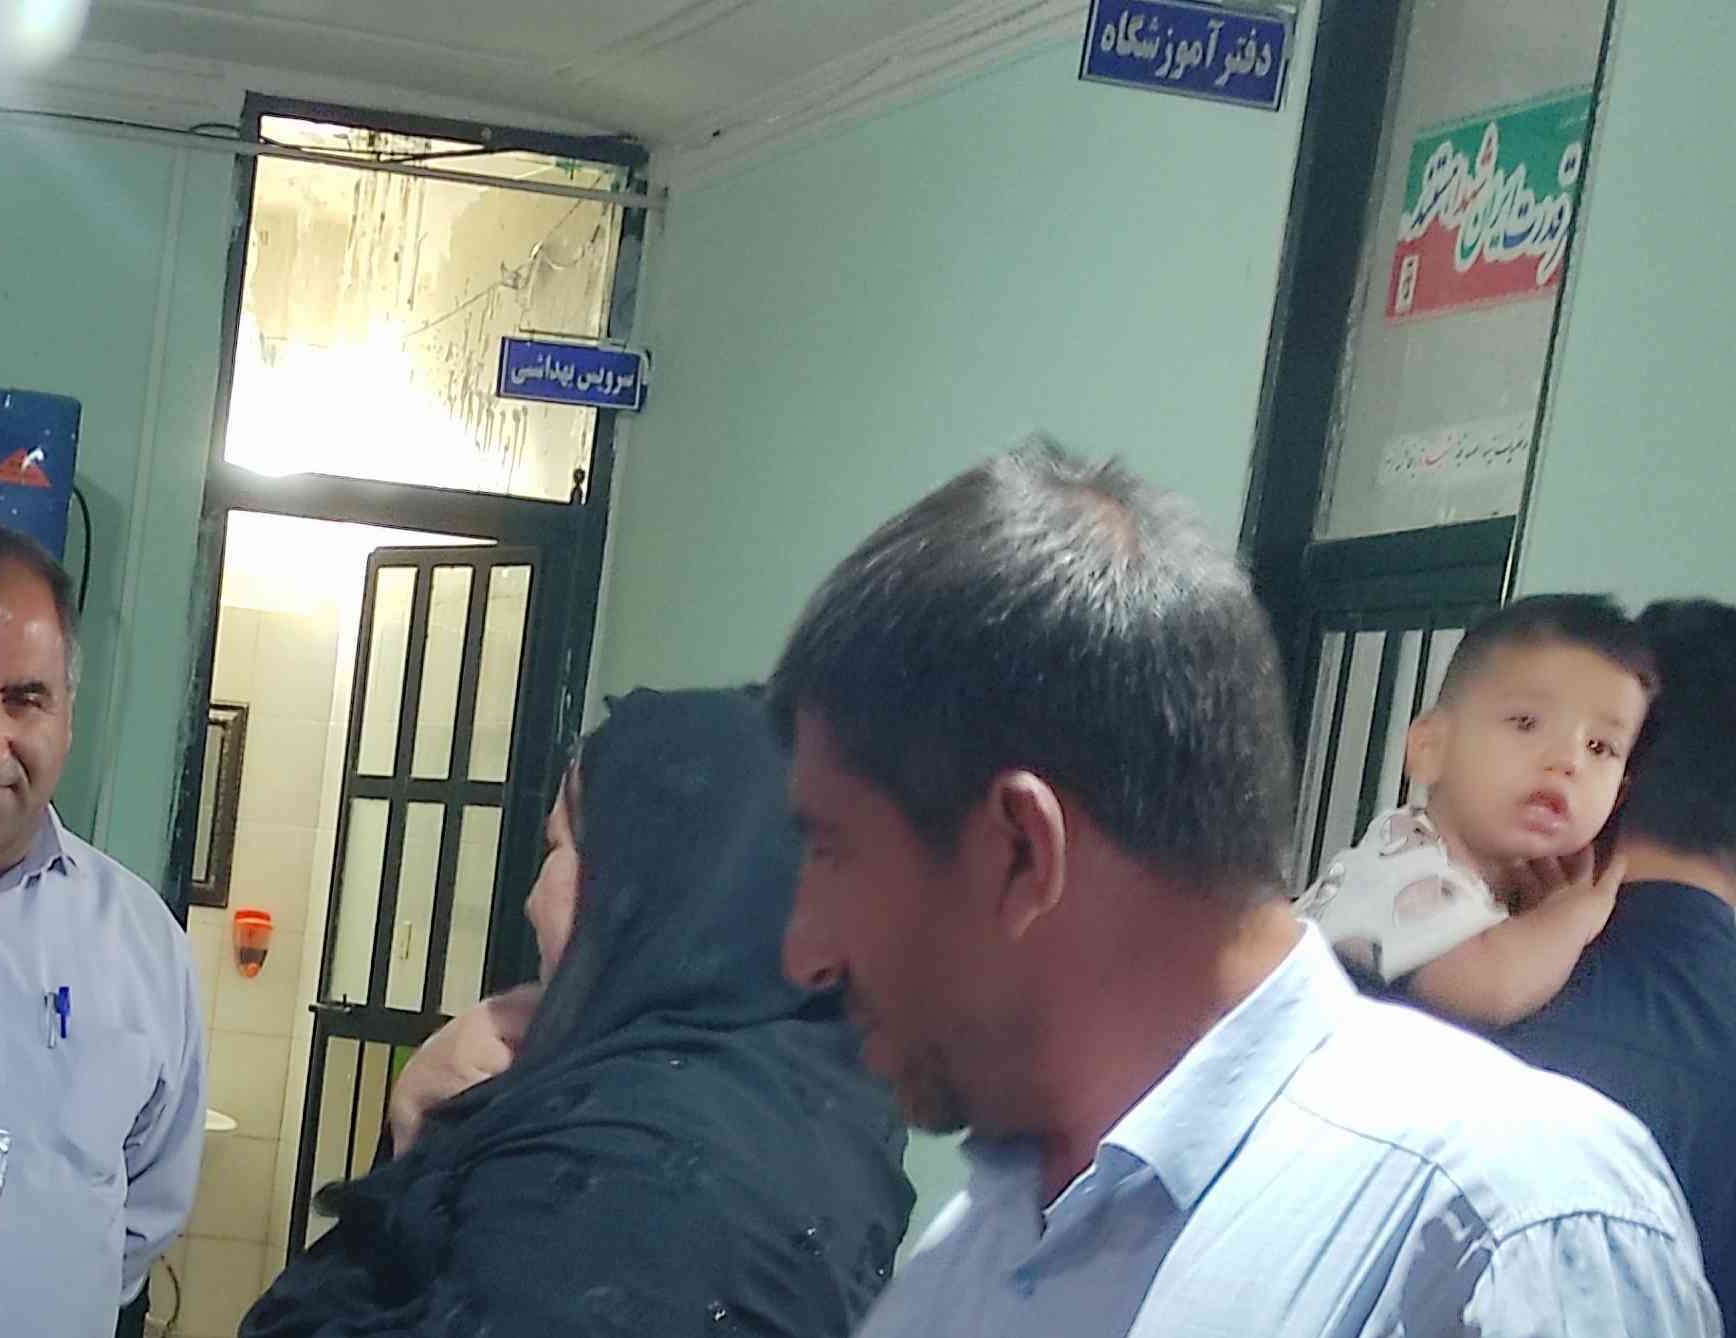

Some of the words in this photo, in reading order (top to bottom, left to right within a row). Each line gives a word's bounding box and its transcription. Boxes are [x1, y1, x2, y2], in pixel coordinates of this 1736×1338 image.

[1099, 10, 1224, 80] آموزشگاه
[1214, 28, 1273, 86] دفتر
[1502, 154, 1577, 276] قدرت
[510, 352, 575, 387] بهداشتی
[576, 367, 635, 396] سرویس
